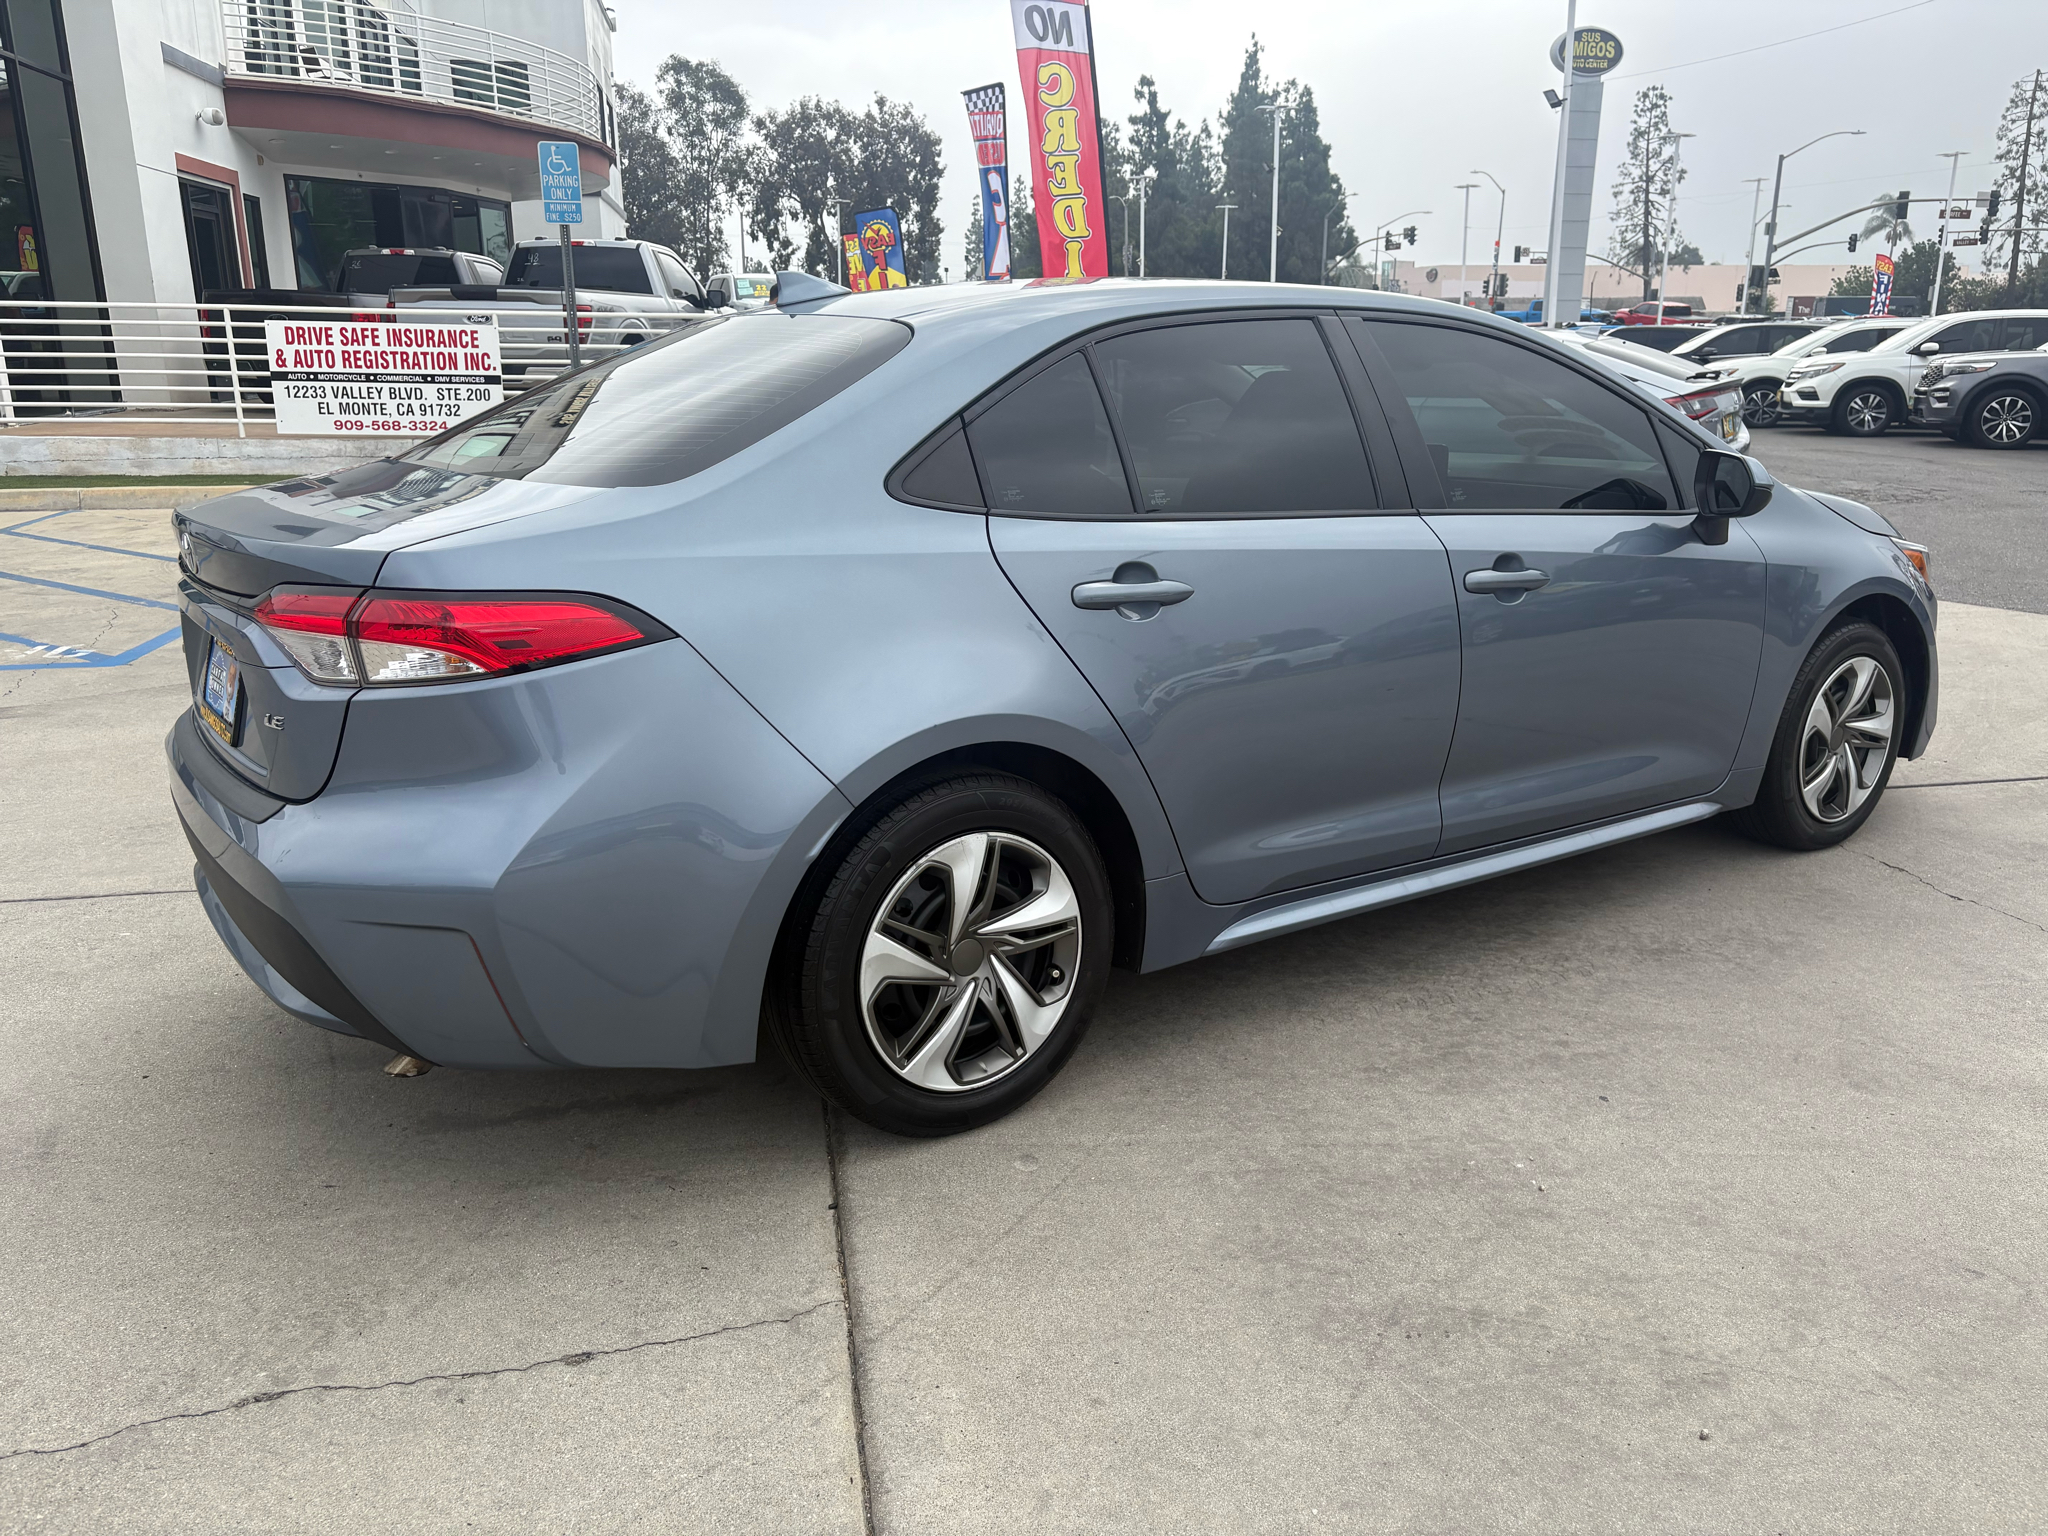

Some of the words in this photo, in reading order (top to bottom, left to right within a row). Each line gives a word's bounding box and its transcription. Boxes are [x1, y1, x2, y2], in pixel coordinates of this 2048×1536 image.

[1582, 32, 1601, 42] SUS
[1562, 41, 1615, 58] MIGOS
[1573, 59, 1584, 68] UTO
[1585, 59, 1608, 68] CENTER
[543, 174, 578, 187] PARKING
[550, 187, 573, 200] ONLY
[549, 203, 576, 212] MINIMUM
[546, 212, 560, 221] FINE
[564, 213, 581, 222] $250
[527, 252, 540, 263] 48
[468, 315, 487, 323] Ford
[284, 326, 333, 345] DRIVE
[339, 327, 380, 347] SAFE
[386, 328, 479, 349] INSURANCE
[275, 348, 288, 369] &
[293, 349, 336, 369] AUTO
[342, 350, 459, 371] REGISTRATION
[464, 352, 497, 372] INC.
[287, 372, 307, 380] AUTO
[317, 373, 366, 381] MOTORCYCLE
[376, 374, 424, 382] COMMERCIAL
[434, 375, 451, 383] DMV
[284, 385, 327, 399] 12233
[331, 386, 384, 400] VALLEY
[389, 387, 428, 401] BLVD.
[436, 388, 491, 402] STE.200
[318, 402, 334, 415] EL
[339, 402, 392, 418] MONTE,
[396, 403, 415, 416] CA
[419, 403, 461, 417] 91732
[333, 420, 449, 432] 909-568-3324
[264, 713, 285, 731] LE
